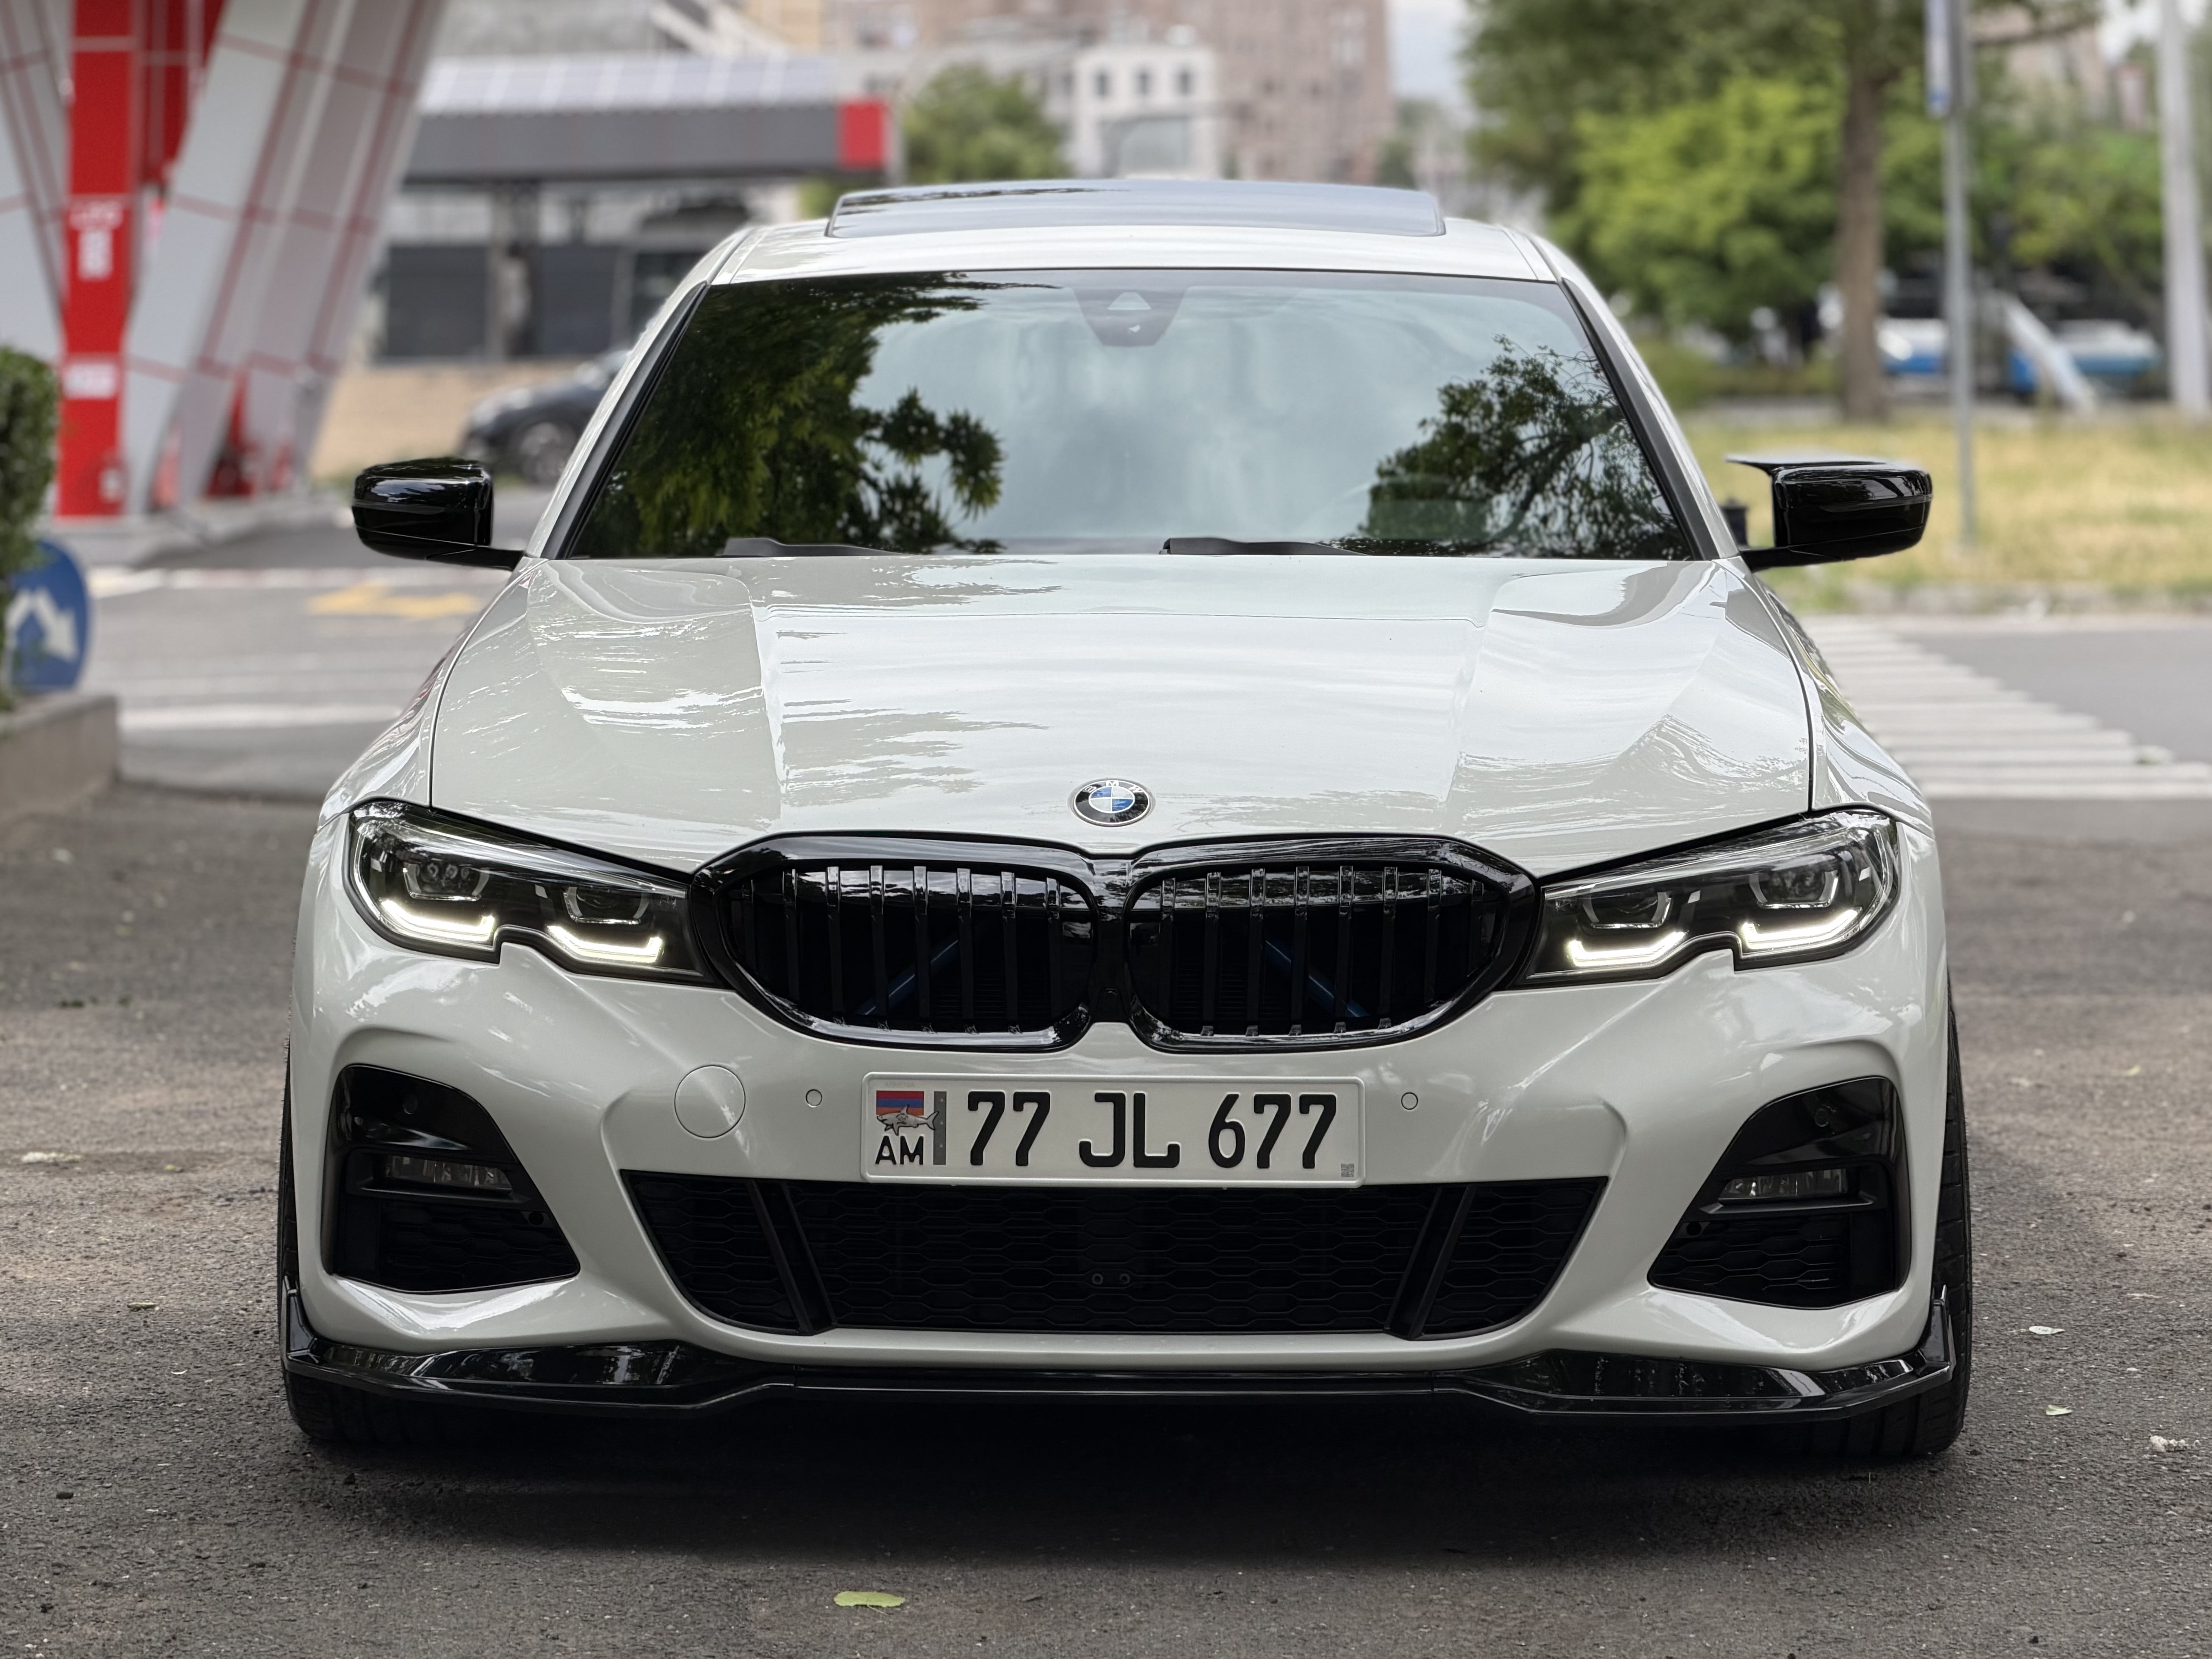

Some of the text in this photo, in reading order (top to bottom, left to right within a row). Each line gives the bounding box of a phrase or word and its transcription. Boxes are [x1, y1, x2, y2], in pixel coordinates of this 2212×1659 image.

[1083, 780, 1145, 793] BMW
[967, 1091, 1337, 1169] 77 JL 677
[875, 1135, 924, 1166] AM
